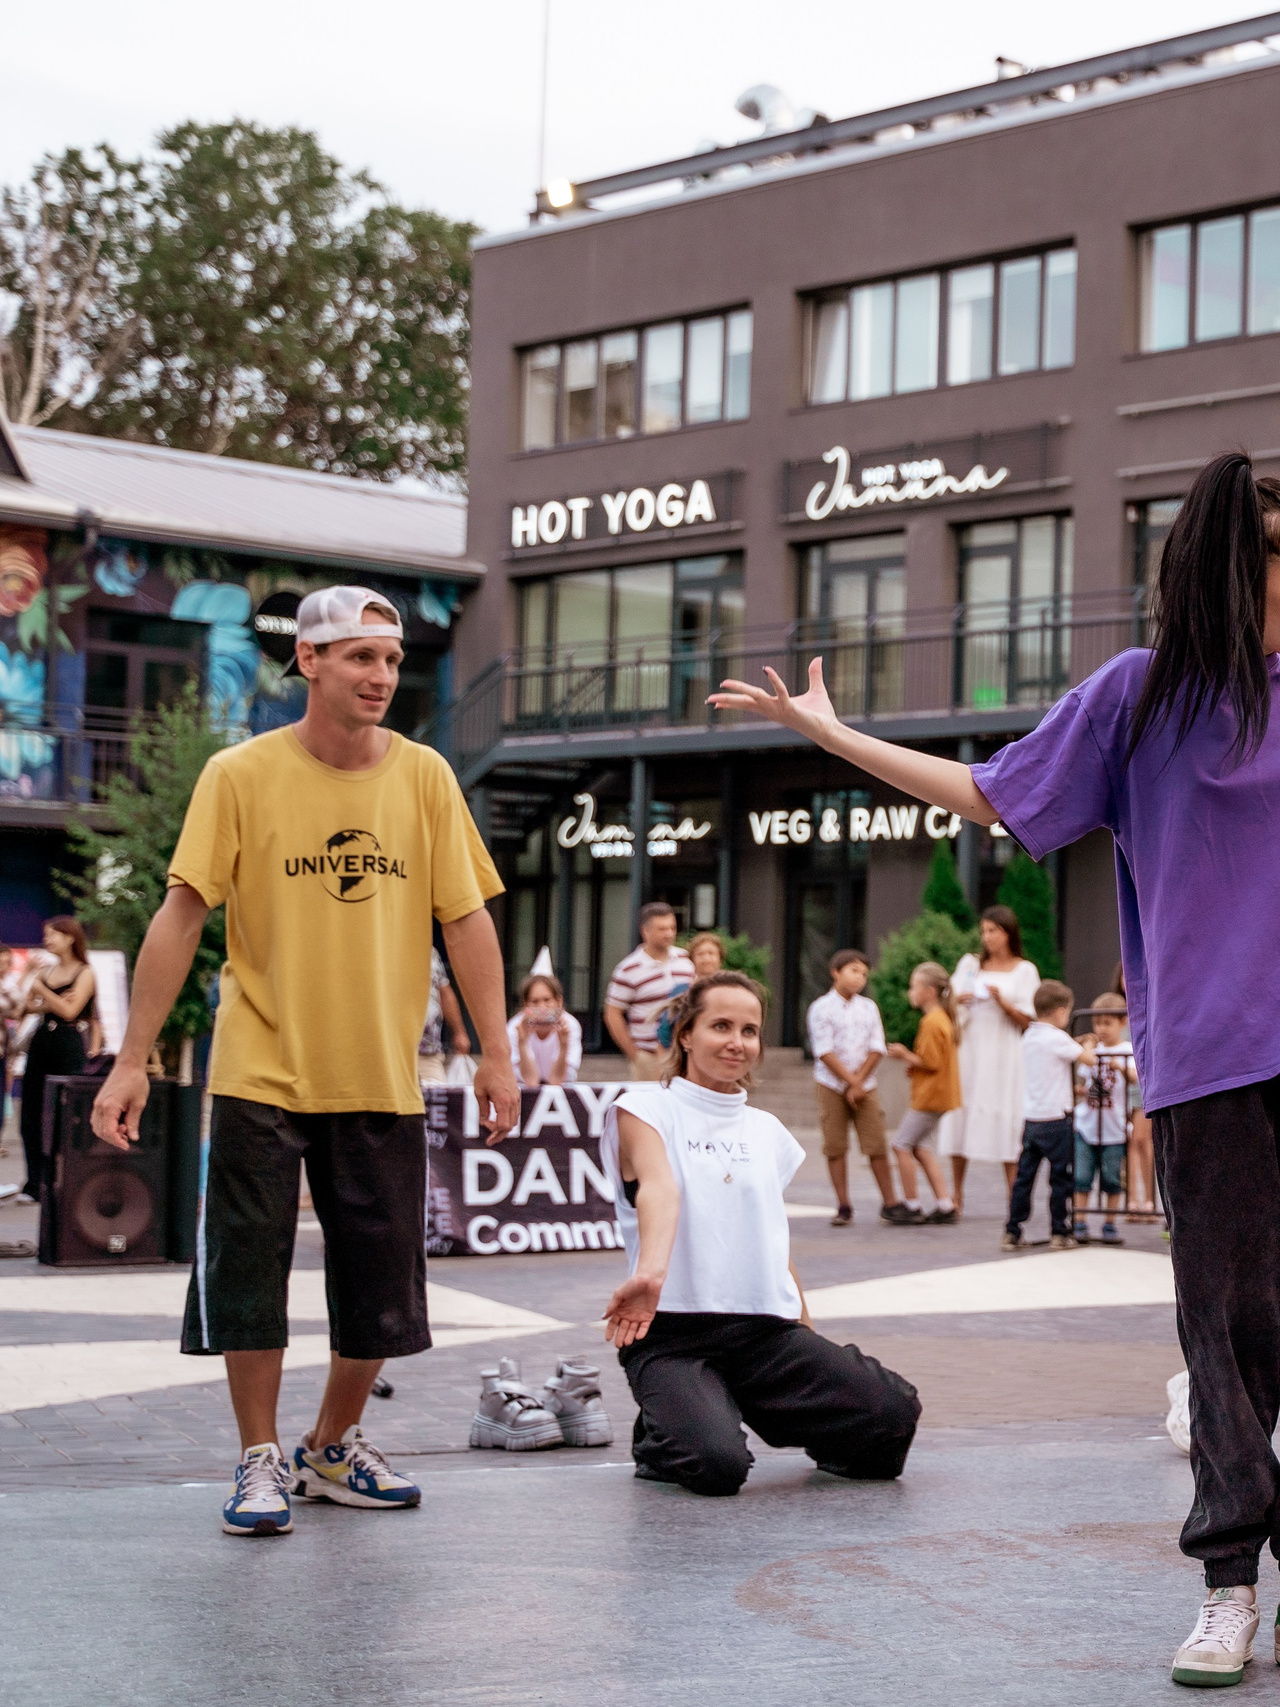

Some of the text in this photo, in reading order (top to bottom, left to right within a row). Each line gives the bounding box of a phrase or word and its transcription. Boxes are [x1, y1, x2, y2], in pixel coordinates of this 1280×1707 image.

[511, 479, 717, 548] HOT YOGA
[556, 792, 712, 849] Jamna
[749, 809, 811, 845] VEG
[819, 808, 841, 843] &
[849, 805, 918, 842] RAW
[285, 855, 407, 880] UNIVERSAL
